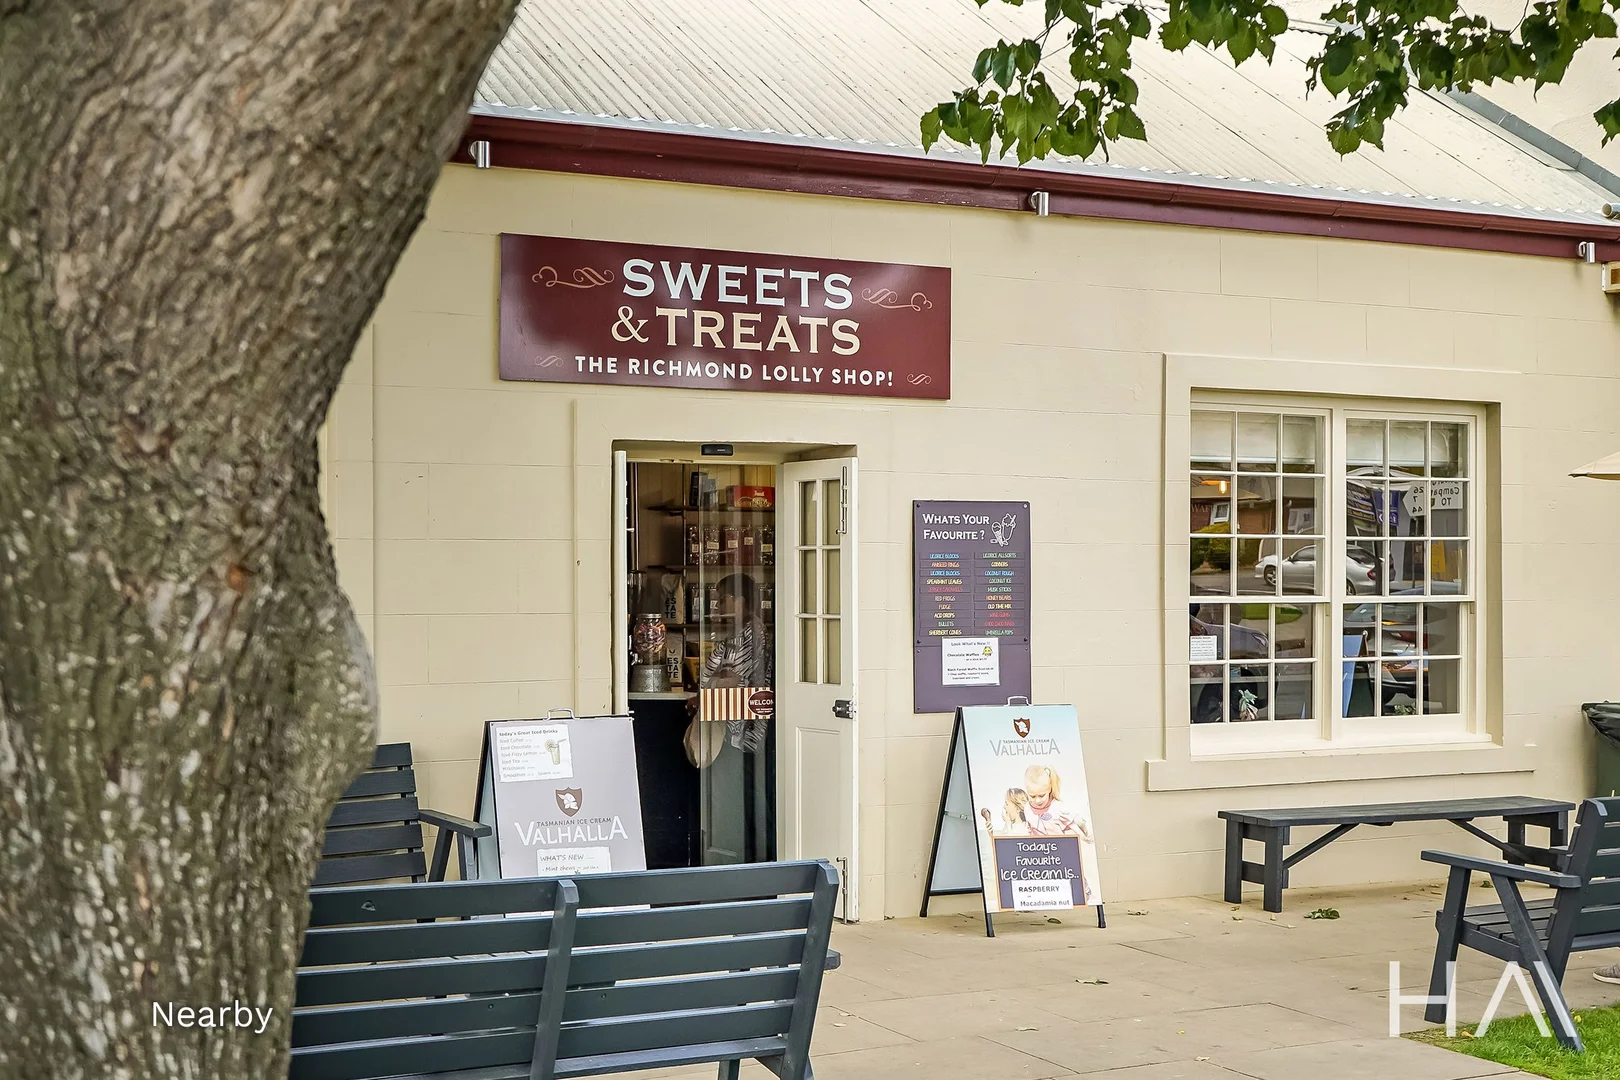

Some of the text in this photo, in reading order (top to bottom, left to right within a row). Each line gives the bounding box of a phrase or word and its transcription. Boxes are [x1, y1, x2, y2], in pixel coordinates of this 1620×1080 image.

[622, 258, 854, 310] SWEETS
[611, 305, 862, 356] & TREATS
[575, 355, 894, 387] THE RICHMOND LOLLY SHOP!
[989, 738, 1061, 756] VALHALLA
[514, 816, 629, 846] VALHALLA
[1016, 842, 1058, 855] Today's
[1000, 868, 1018, 880] Ice
